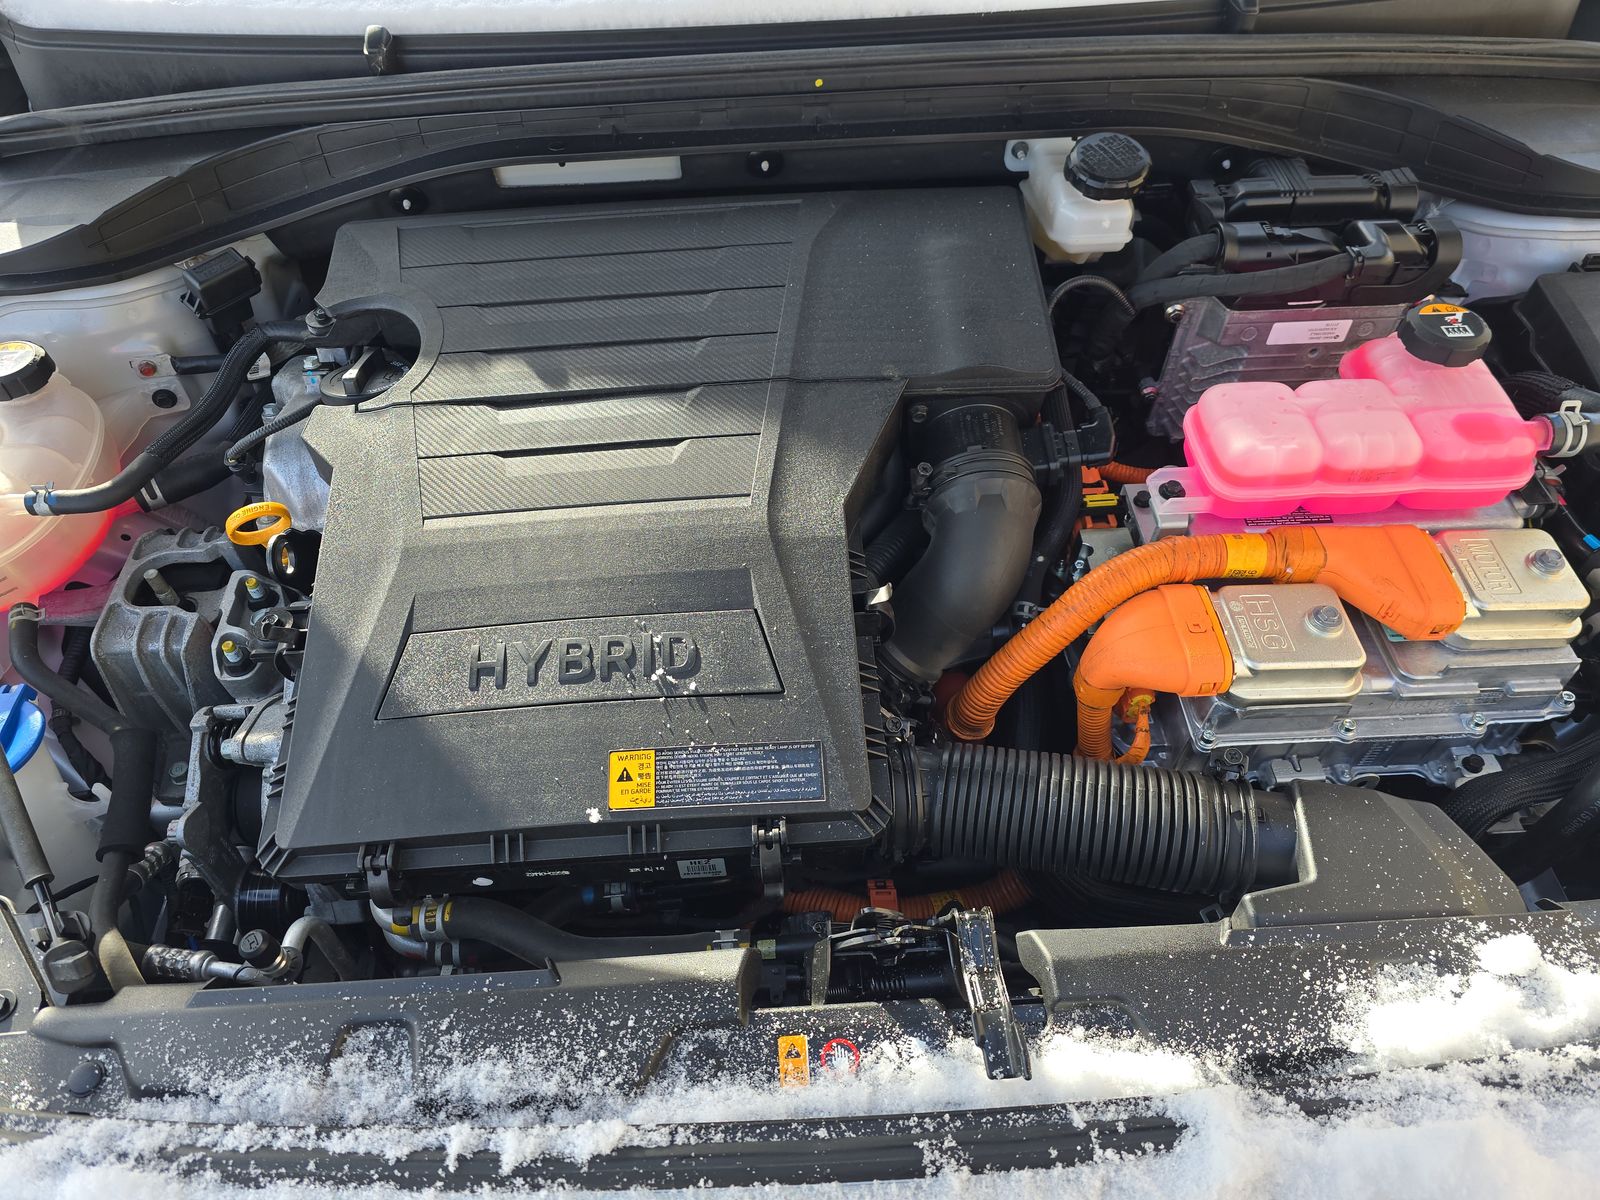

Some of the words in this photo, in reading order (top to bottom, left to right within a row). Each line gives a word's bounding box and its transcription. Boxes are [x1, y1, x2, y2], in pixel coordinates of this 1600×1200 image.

[1466, 544, 1512, 591] MOTOR
[1246, 600, 1287, 649] HSG
[468, 631, 698, 692] HYBRID
